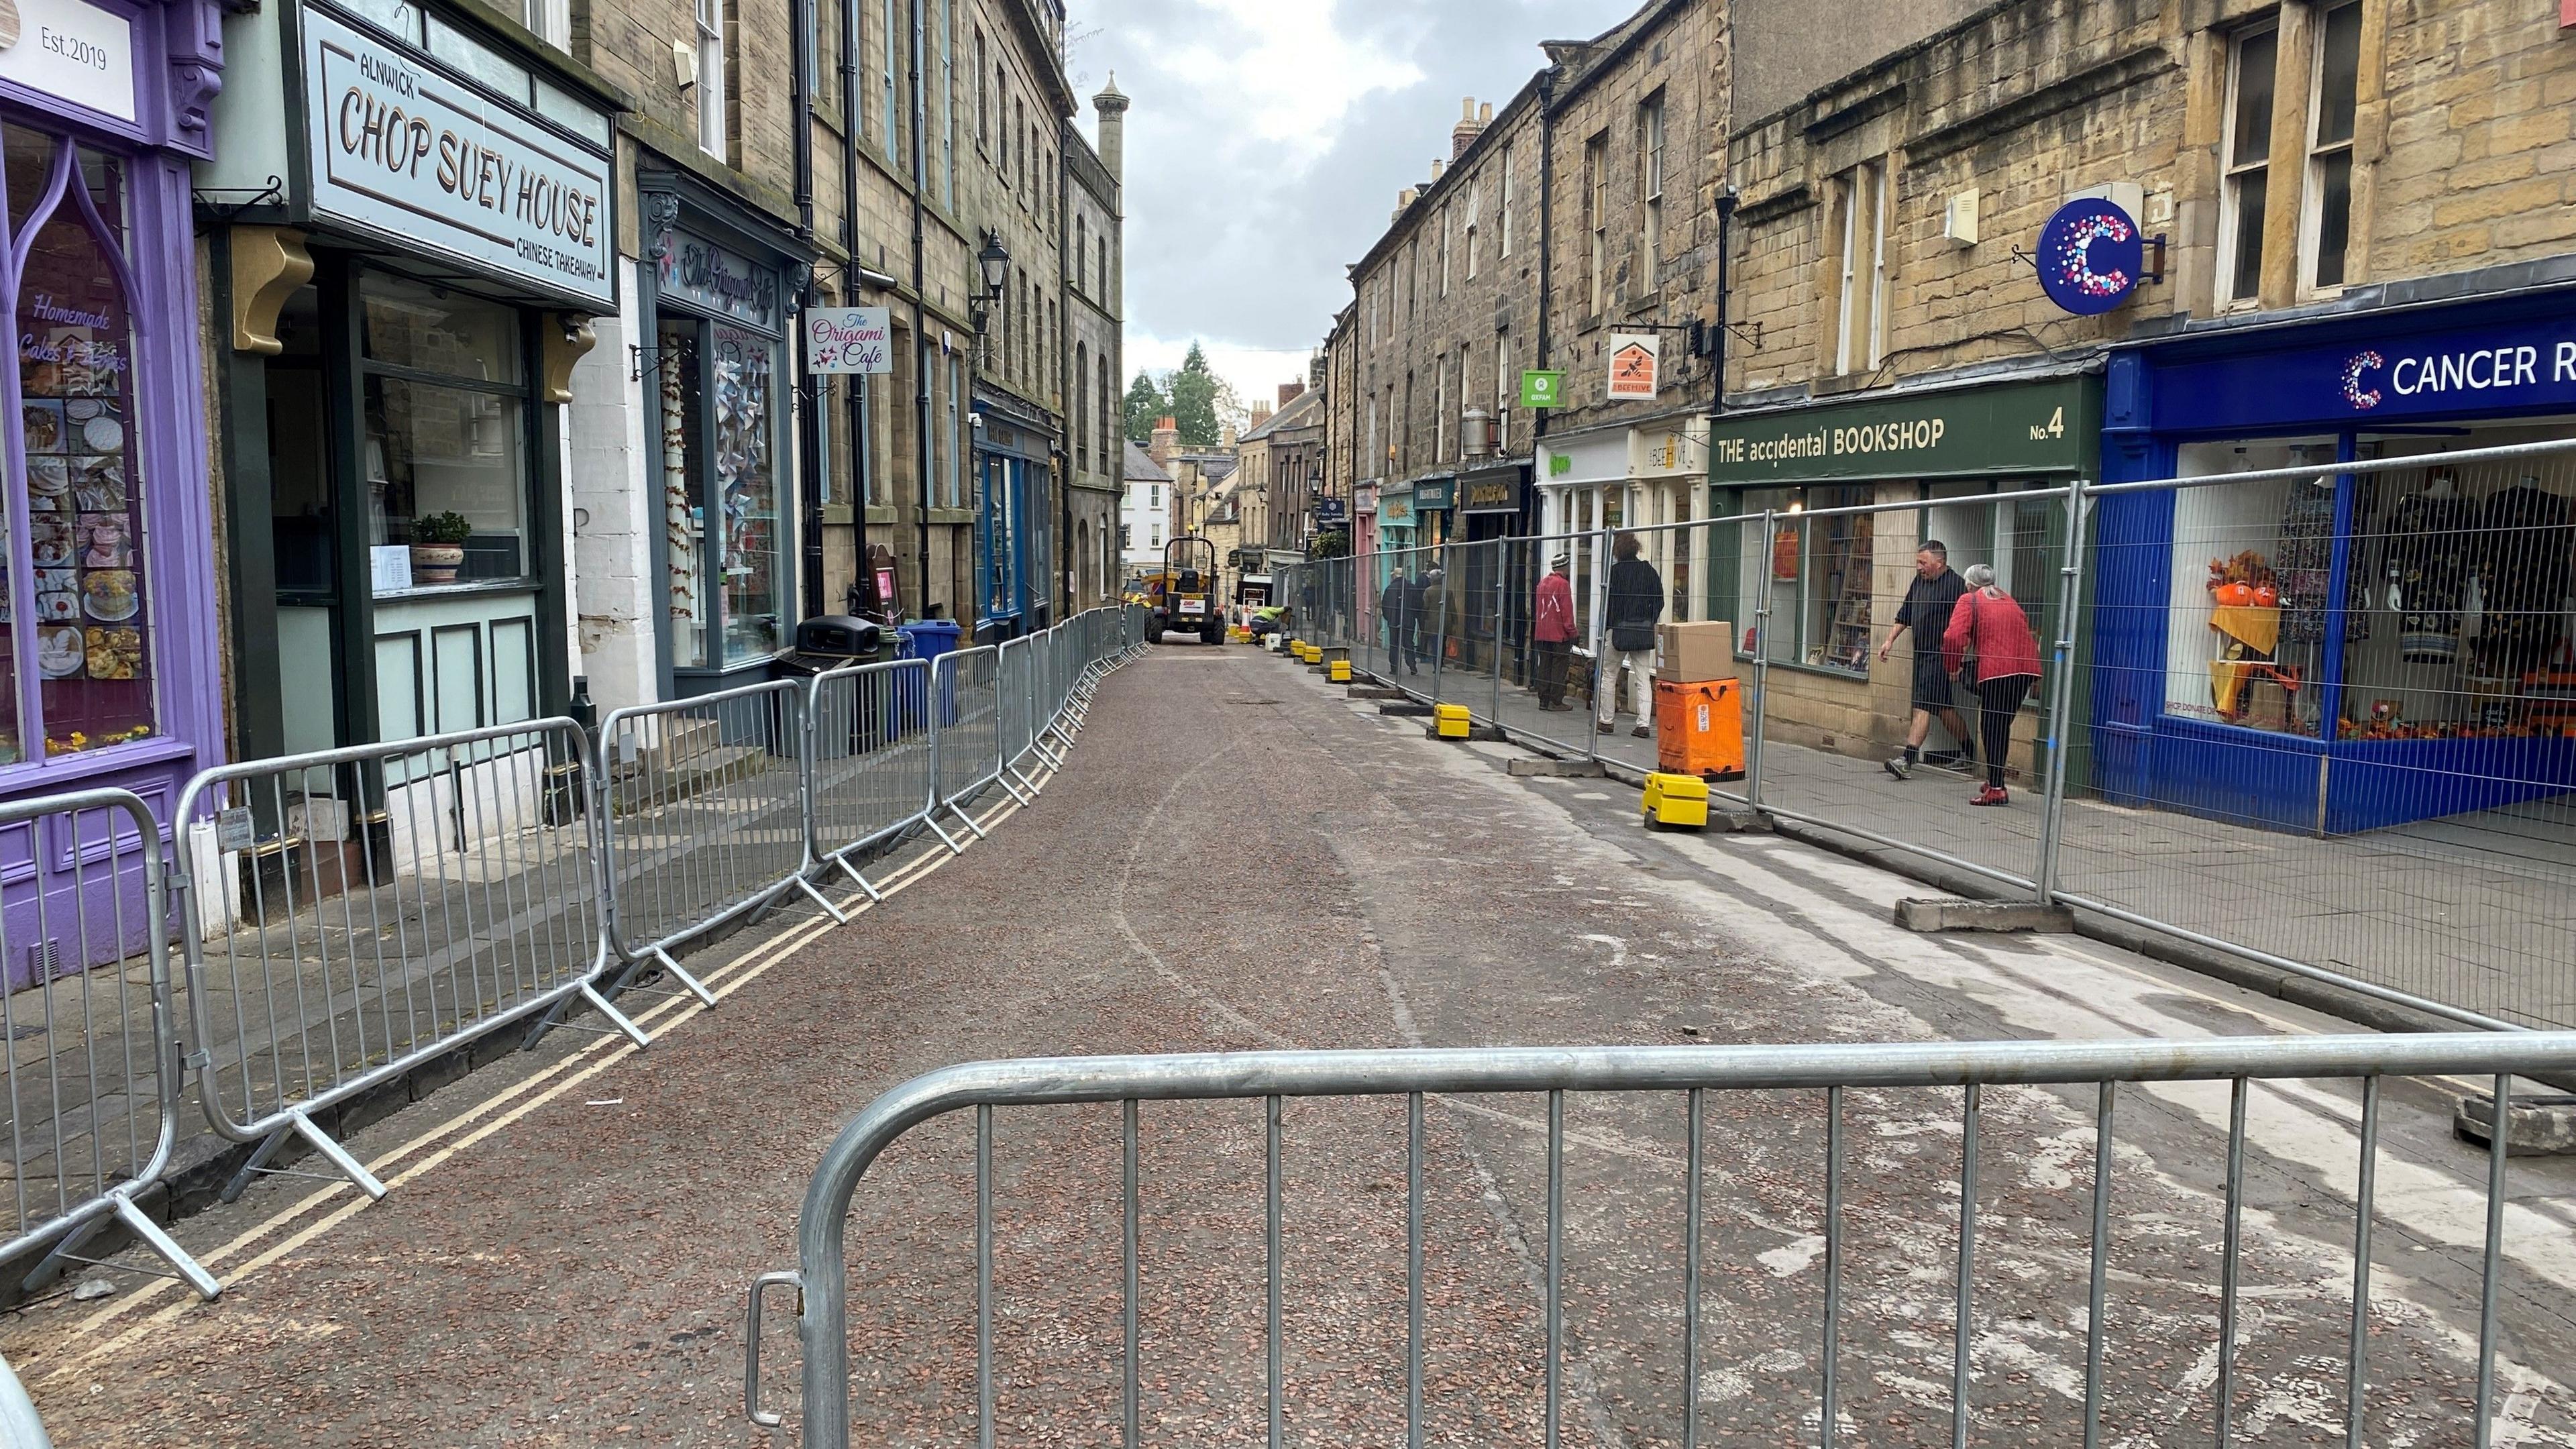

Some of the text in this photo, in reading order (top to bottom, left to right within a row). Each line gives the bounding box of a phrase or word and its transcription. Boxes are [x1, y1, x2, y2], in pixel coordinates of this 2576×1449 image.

[361, 52, 415, 100] ALNWICK
[339, 86, 597, 248] CHOP SUEY HOUSE
[517, 237, 597, 282] CHINESE TAKEAWAY
[708, 246, 752, 311] Origami
[34, 294, 110, 330] Homemade
[843, 313, 867, 328] The
[19, 333, 61, 362] Cakes
[812, 319, 885, 344] Origami
[841, 342, 883, 372] Café
[2393, 345, 2537, 395] CANCER
[1530, 393, 1551, 401] OXFAM
[1652, 445, 1686, 468] BEEHIVE
[1719, 439, 1744, 463] THE
[1833, 419, 1945, 455] BOOKSHOP
[2182, 703, 2206, 714] DONATE
